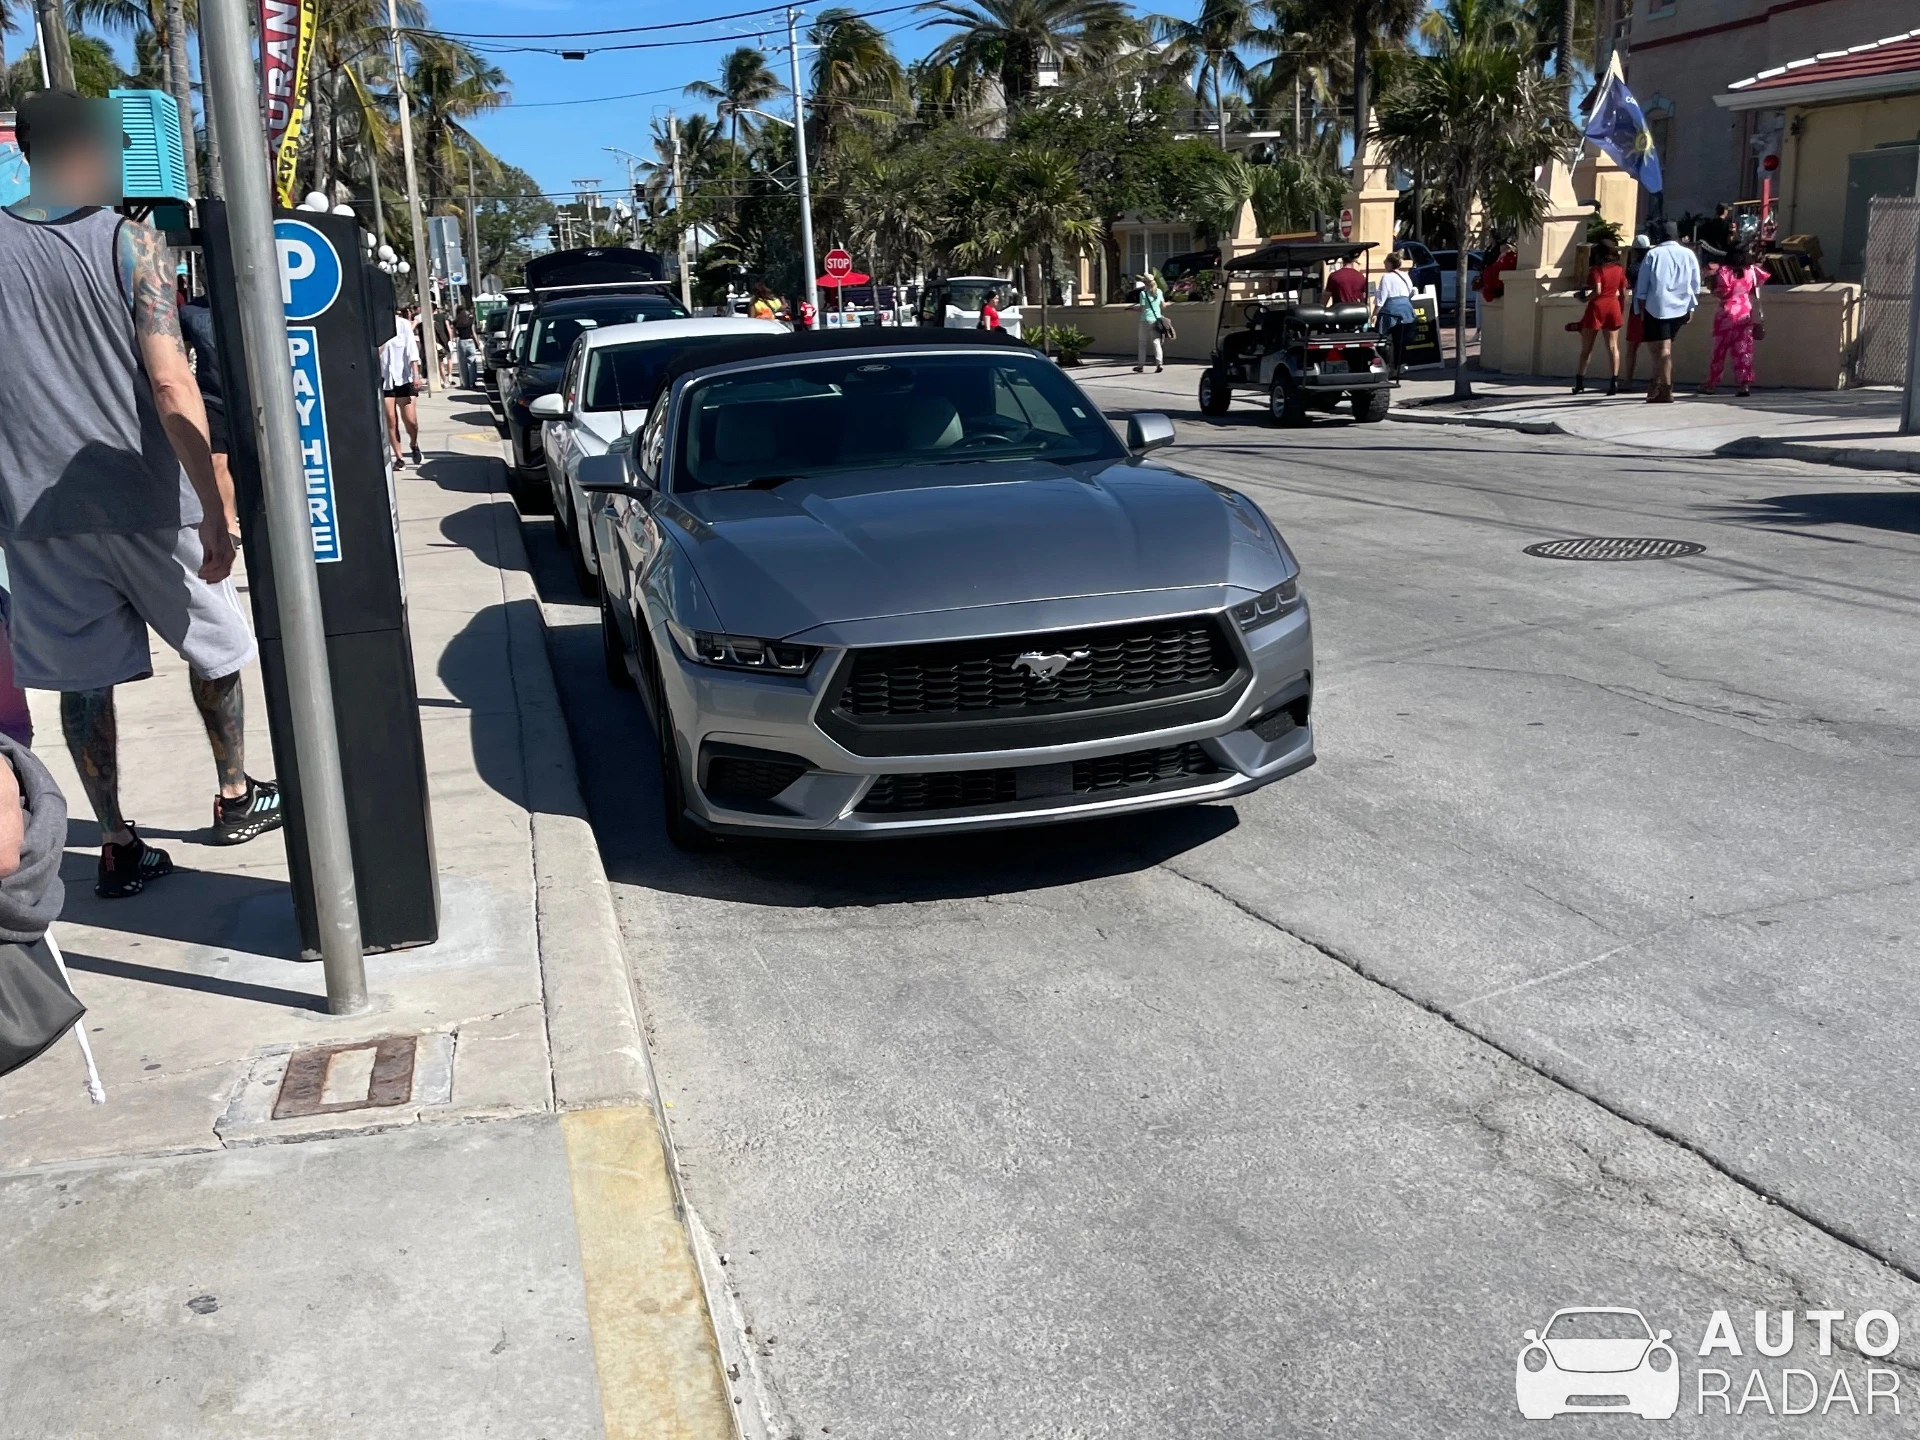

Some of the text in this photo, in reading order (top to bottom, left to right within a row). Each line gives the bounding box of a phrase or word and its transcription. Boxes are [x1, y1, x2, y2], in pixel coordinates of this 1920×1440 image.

[275, 239, 316, 304] P
[827, 258, 850, 269] STOP
[288, 338, 334, 552] PAY HERE
